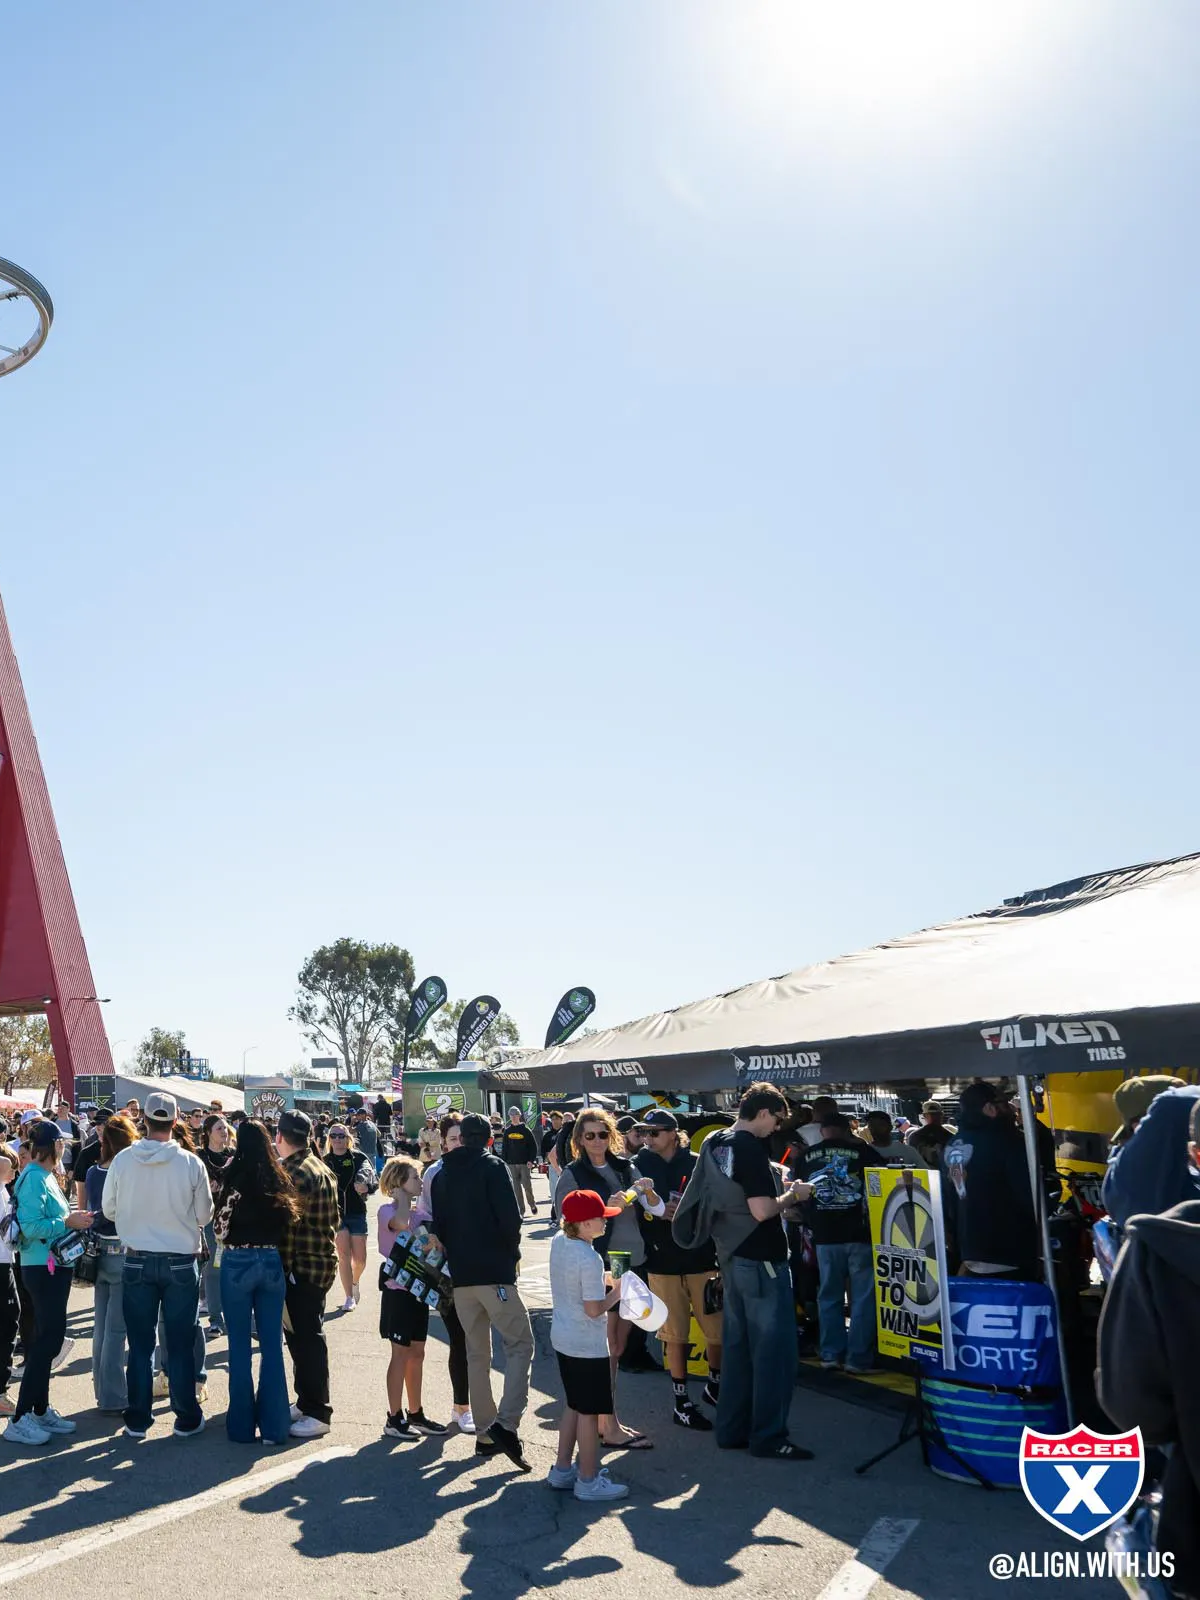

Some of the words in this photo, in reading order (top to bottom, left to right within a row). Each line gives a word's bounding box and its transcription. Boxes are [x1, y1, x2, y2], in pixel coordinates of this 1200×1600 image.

[468, 1020, 489, 1044] RAISED
[486, 1010, 497, 1022] ME
[980, 1020, 1121, 1051] FALKEN
[747, 1051, 821, 1070] DUNLOP
[1087, 1046, 1127, 1062] TIRES
[499, 1071, 530, 1080] DUNLOP
[745, 1069, 795, 1080] MOTORCYCLE
[798, 1068, 821, 1078] TIRES
[436, 1094, 452, 1115] 2
[876, 1253, 927, 1284] SPIN
[878, 1280, 905, 1306] TO
[880, 1306, 920, 1338] WIN
